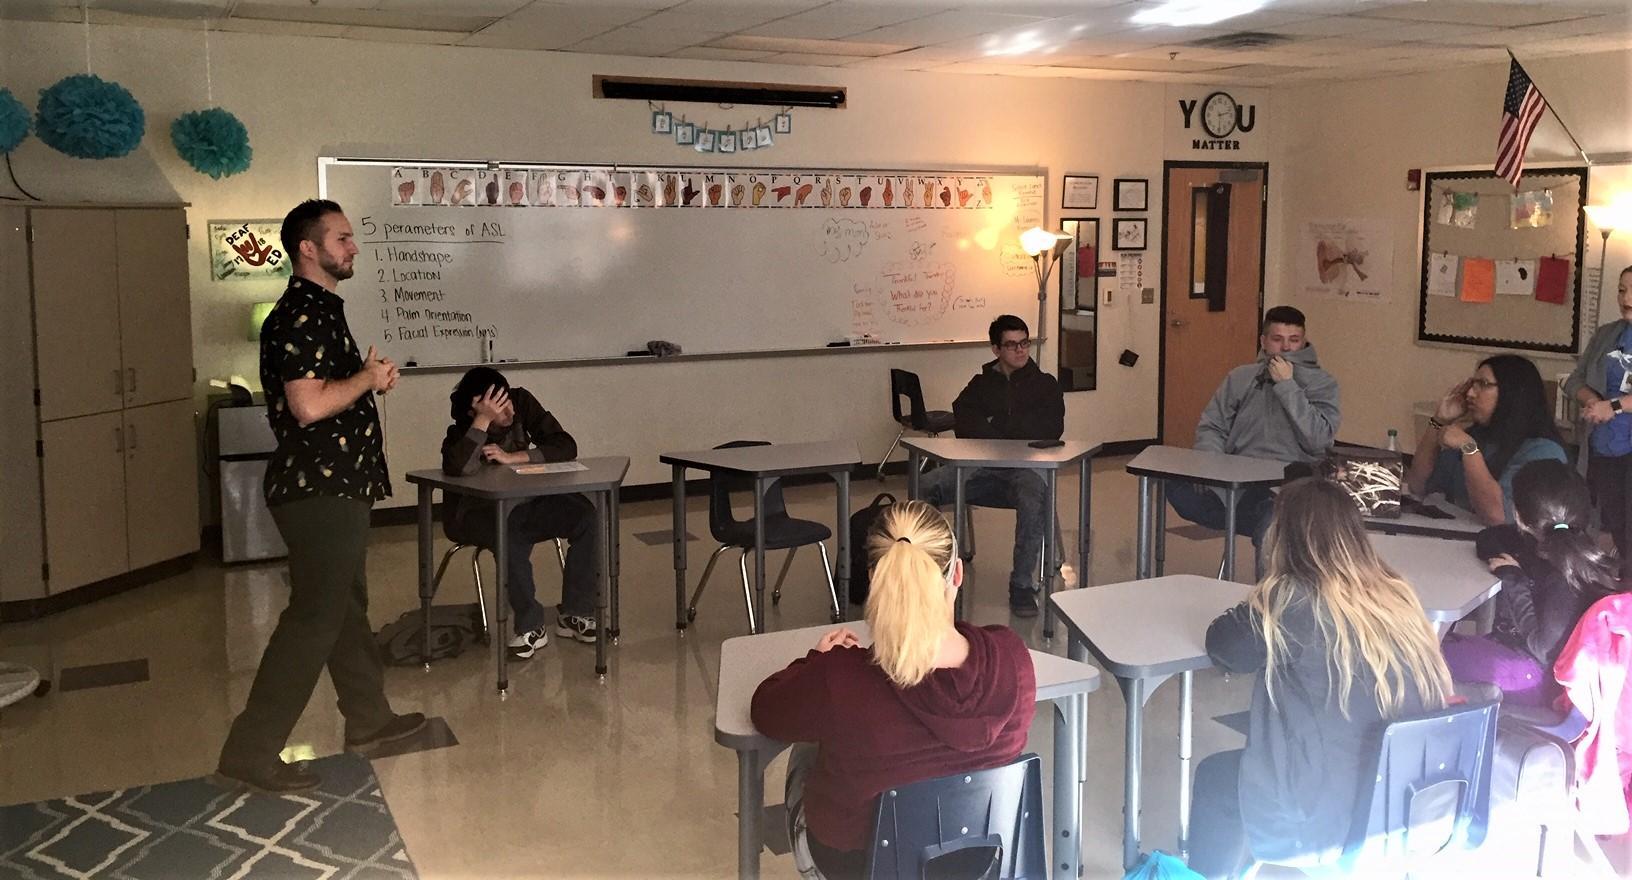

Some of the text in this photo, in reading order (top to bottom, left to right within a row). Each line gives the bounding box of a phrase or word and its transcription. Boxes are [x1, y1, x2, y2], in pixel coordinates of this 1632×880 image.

[1192, 139, 1240, 150] MATTER
[394, 170, 402, 178] A
[422, 170, 430, 178] B
[450, 171, 458, 179] C
[478, 171, 487, 179] D
[505, 172, 512, 180] E
[532, 172, 538, 180] F
[558, 173, 566, 181] G
[584, 173, 591, 181] H
[657, 174, 665, 182] K
[681, 174, 687, 182] L
[705, 175, 714, 183] M
[749, 176, 757, 184] O
[771, 176, 777, 184] P
[793, 176, 801, 185] Q
[815, 176, 821, 184] R
[835, 177, 841, 185] S
[858, 177, 862, 185] T
[937, 178, 943, 186] X
[957, 178, 963, 186] Y
[225, 223, 250, 245] DEAF
[361, 216, 506, 240] 5 perameters of ASL
[257, 237, 266, 246] 18
[233, 255, 245, 265] 17
[266, 249, 282, 266] ED
[375, 247, 453, 268] 1. Handshape
[392, 267, 441, 283] Location
[394, 287, 445, 302] Movement
[396, 307, 420, 320] Palm
[424, 308, 472, 323] Orientation
[398, 325, 428, 341] Facial
[432, 325, 474, 340] Expression
